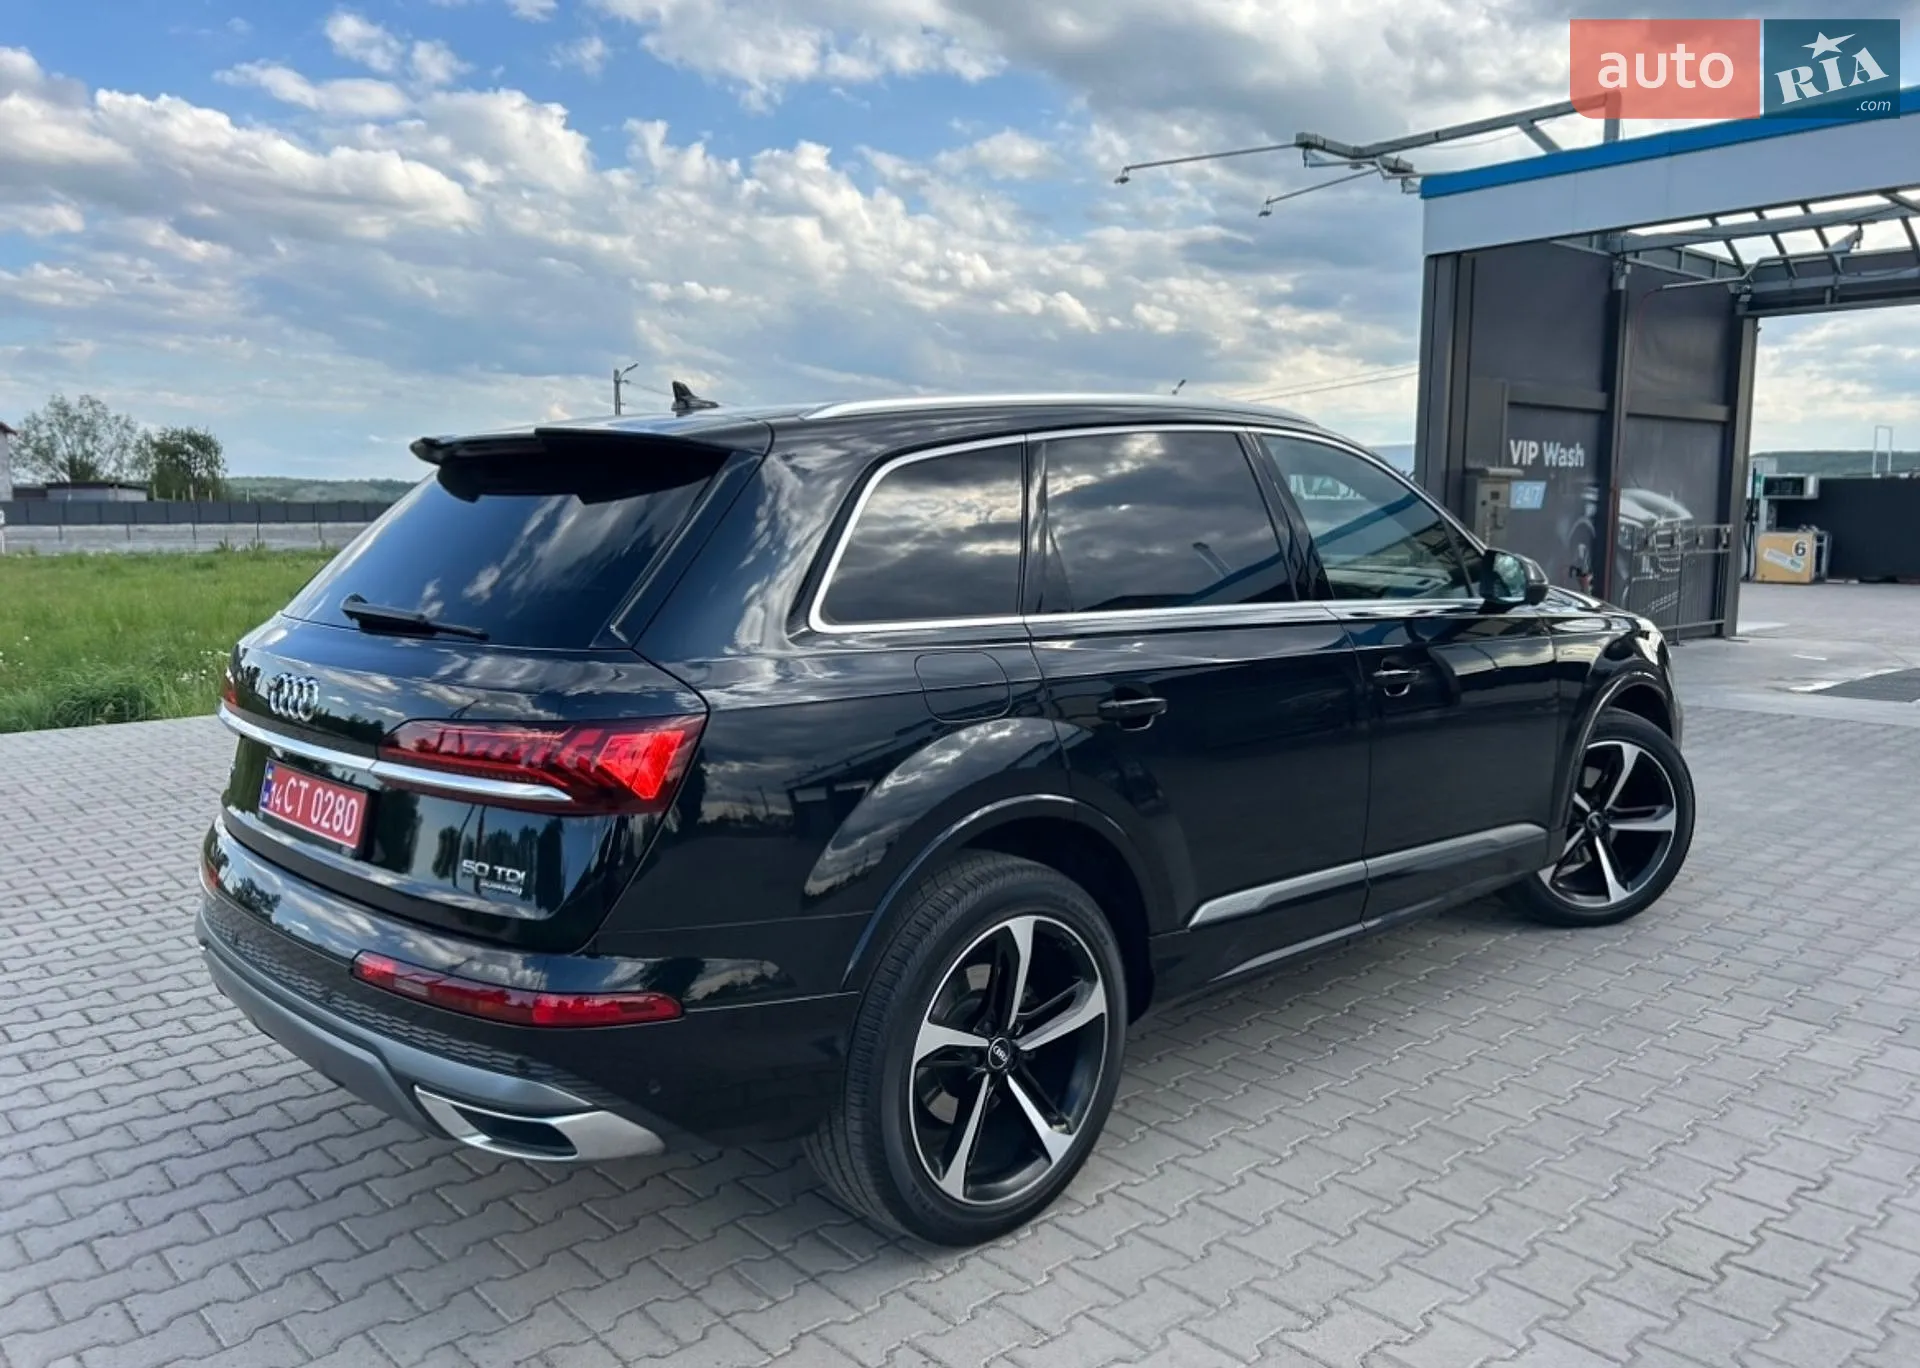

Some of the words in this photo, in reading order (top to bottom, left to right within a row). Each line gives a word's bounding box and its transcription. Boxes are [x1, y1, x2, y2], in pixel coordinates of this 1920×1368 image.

[1510, 439, 1539, 466] VIP
[1542, 441, 1585, 467] Wash
[1794, 541, 1806, 557] 6
[311, 785, 358, 837] 0280
[462, 859, 490, 877] 50
[493, 865, 526, 885] TDI
